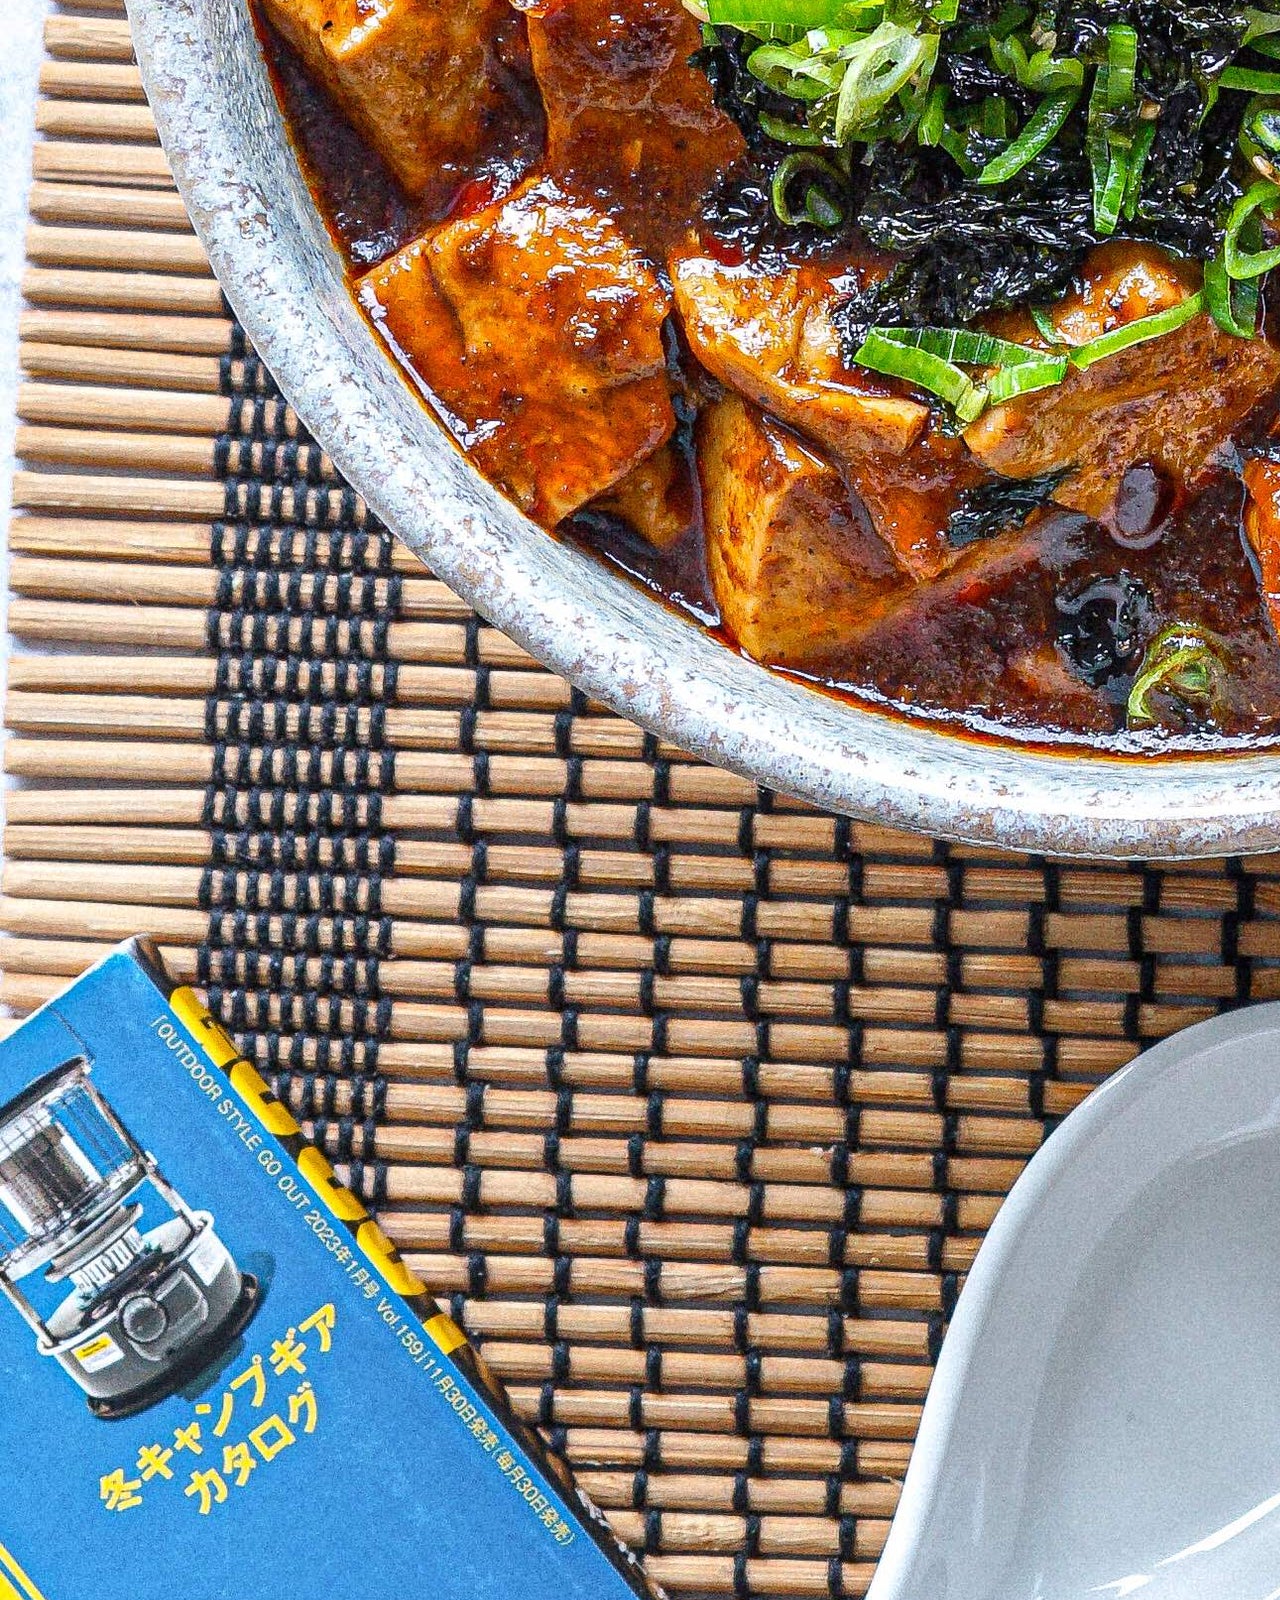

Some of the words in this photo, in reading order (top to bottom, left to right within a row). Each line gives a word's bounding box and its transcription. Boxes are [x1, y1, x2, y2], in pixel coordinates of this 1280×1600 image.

[217, 1099, 263, 1152] STYLE
[256, 1148, 283, 1177] GO
[277, 1175, 311, 1210] OUT
[99, 1303, 336, 1512] 冬キャンプギア
[184, 1381, 319, 1515] カタログ
